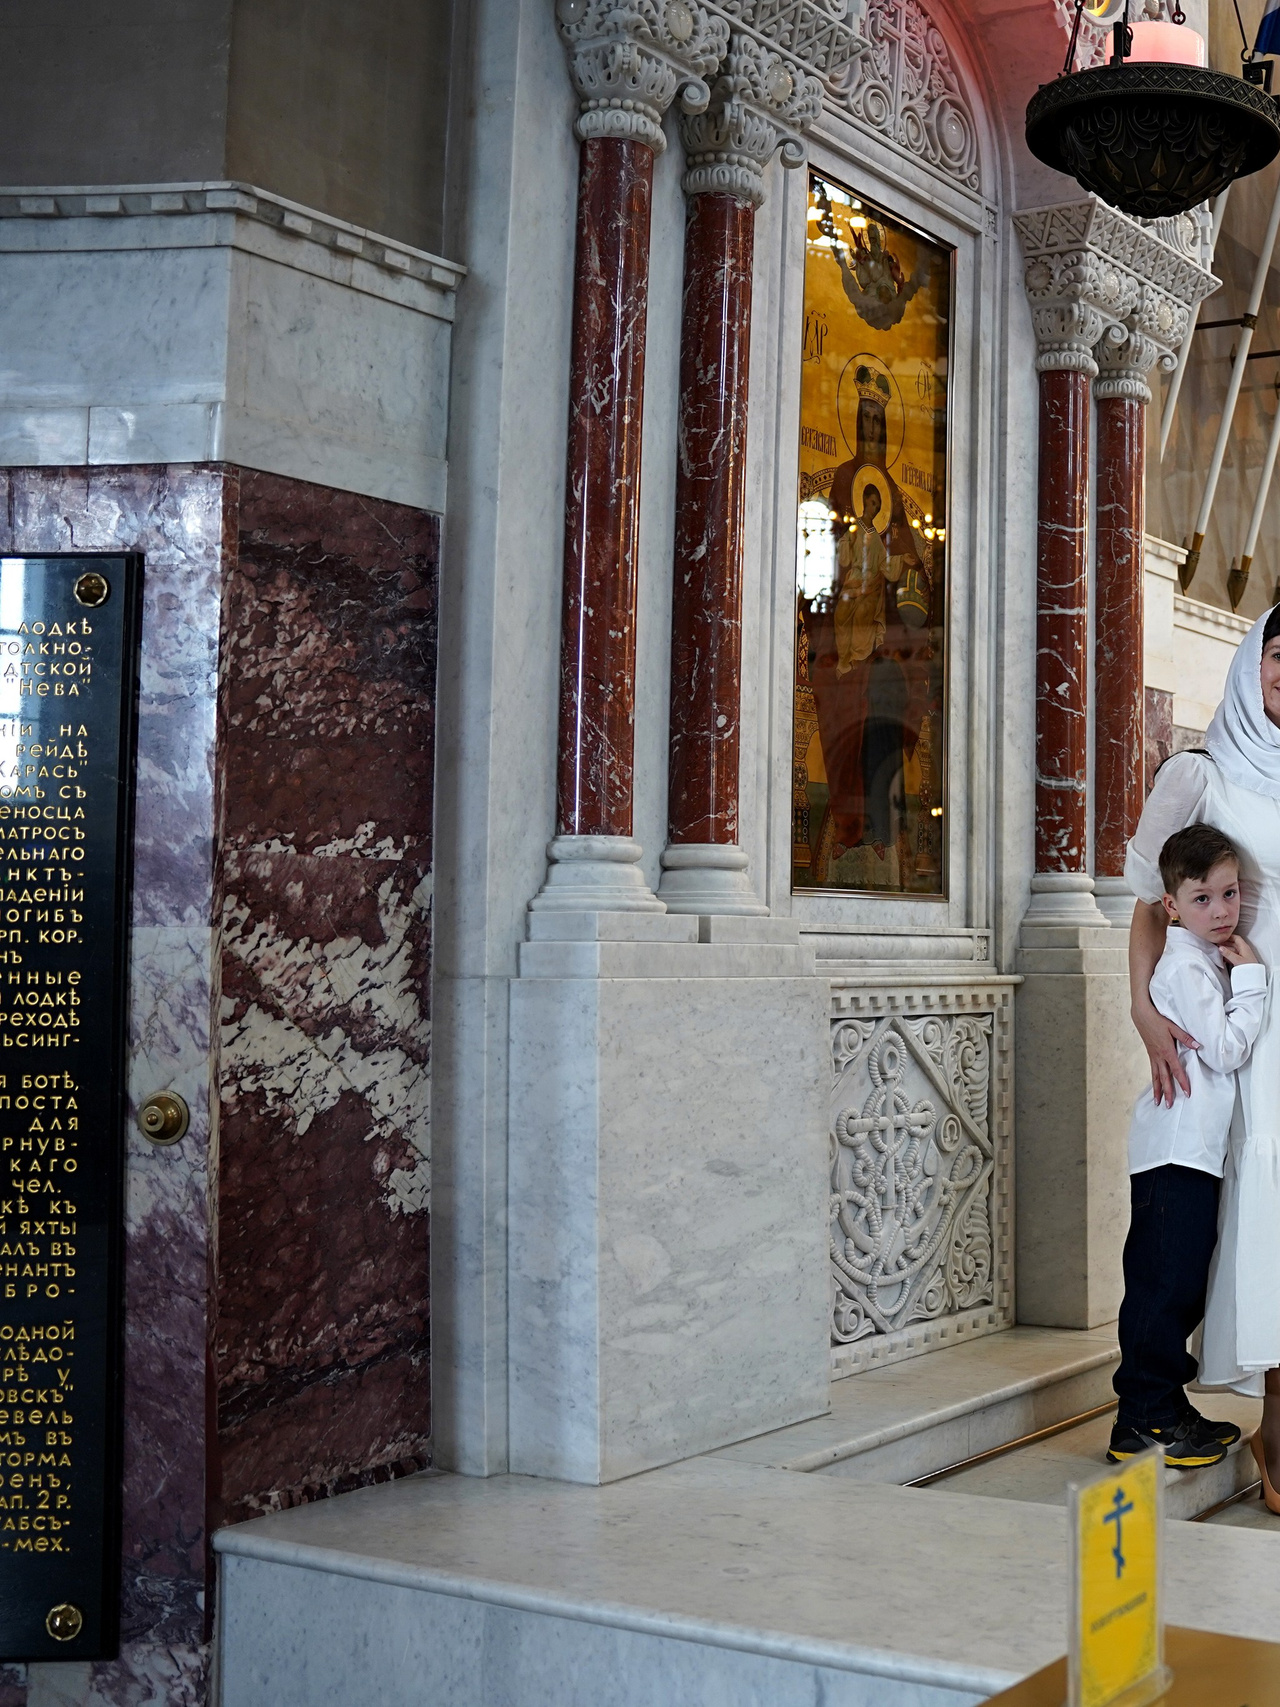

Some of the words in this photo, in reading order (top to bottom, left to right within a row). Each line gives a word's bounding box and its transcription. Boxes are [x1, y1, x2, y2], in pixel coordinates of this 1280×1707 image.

[60, 723, 89, 737] НА
[59, 784, 87, 799] СЪ
[38, 929, 84, 944] КОР.
[0, 970, 82, 986] ННЫЕ
[12, 987, 81, 1008] ЛОДКѢ
[28, 1116, 79, 1133] ДЛЯ
[10, 1158, 78, 1173] КАГО
[49, 1200, 77, 1215] КЪ
[20, 1221, 77, 1236] ЯХТЫ
[50, 1242, 77, 1257] ВЪ
[0, 1262, 76, 1278] НАНТЪ
[0, 1342, 74, 1364] ЛѢДО-
[45, 1431, 73, 1446] ВЪ
[0, 1515, 71, 1532] АБСЪ-
